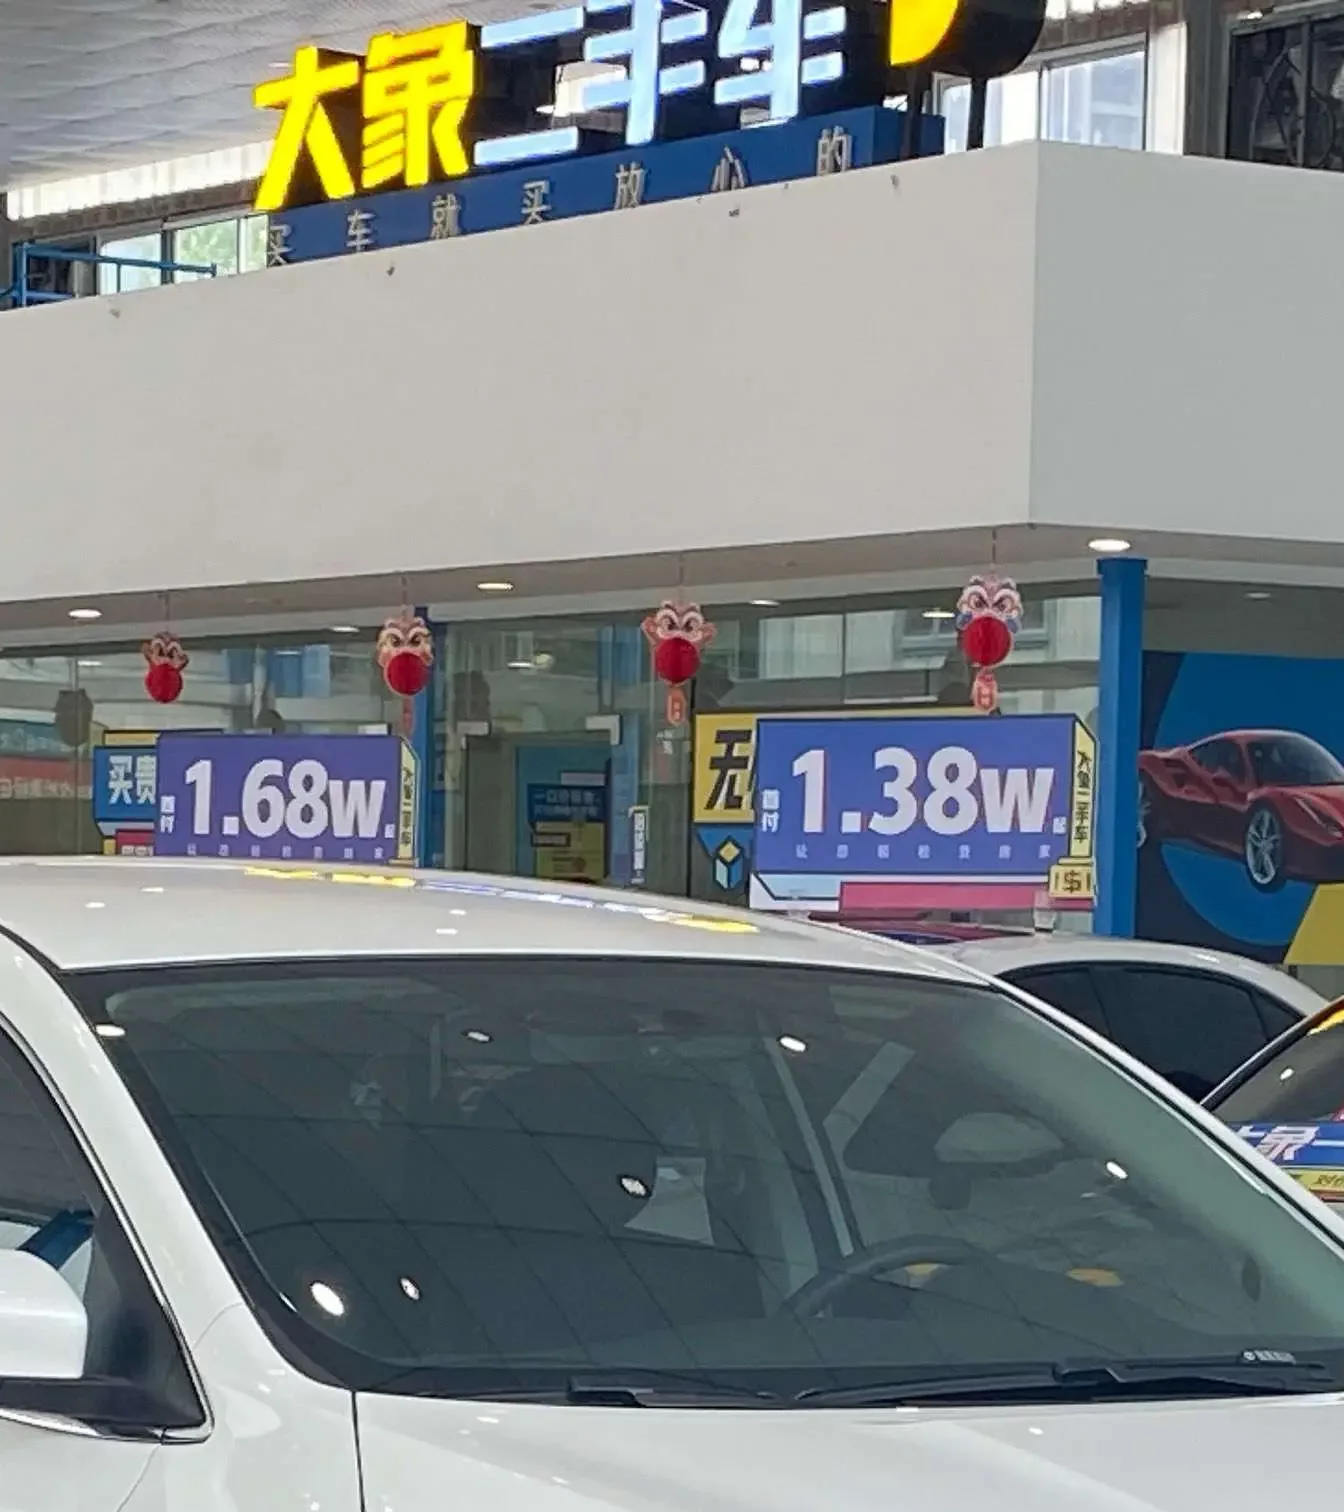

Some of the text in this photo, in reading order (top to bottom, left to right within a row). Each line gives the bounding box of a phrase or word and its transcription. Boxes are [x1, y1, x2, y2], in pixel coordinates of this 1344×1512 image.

[254, 0, 844, 211] 大象二手车
[266, 127, 853, 267] 买车就买放心的
[184, 759, 387, 839] 1.68w
[792, 745, 1055, 836] 1.38w
